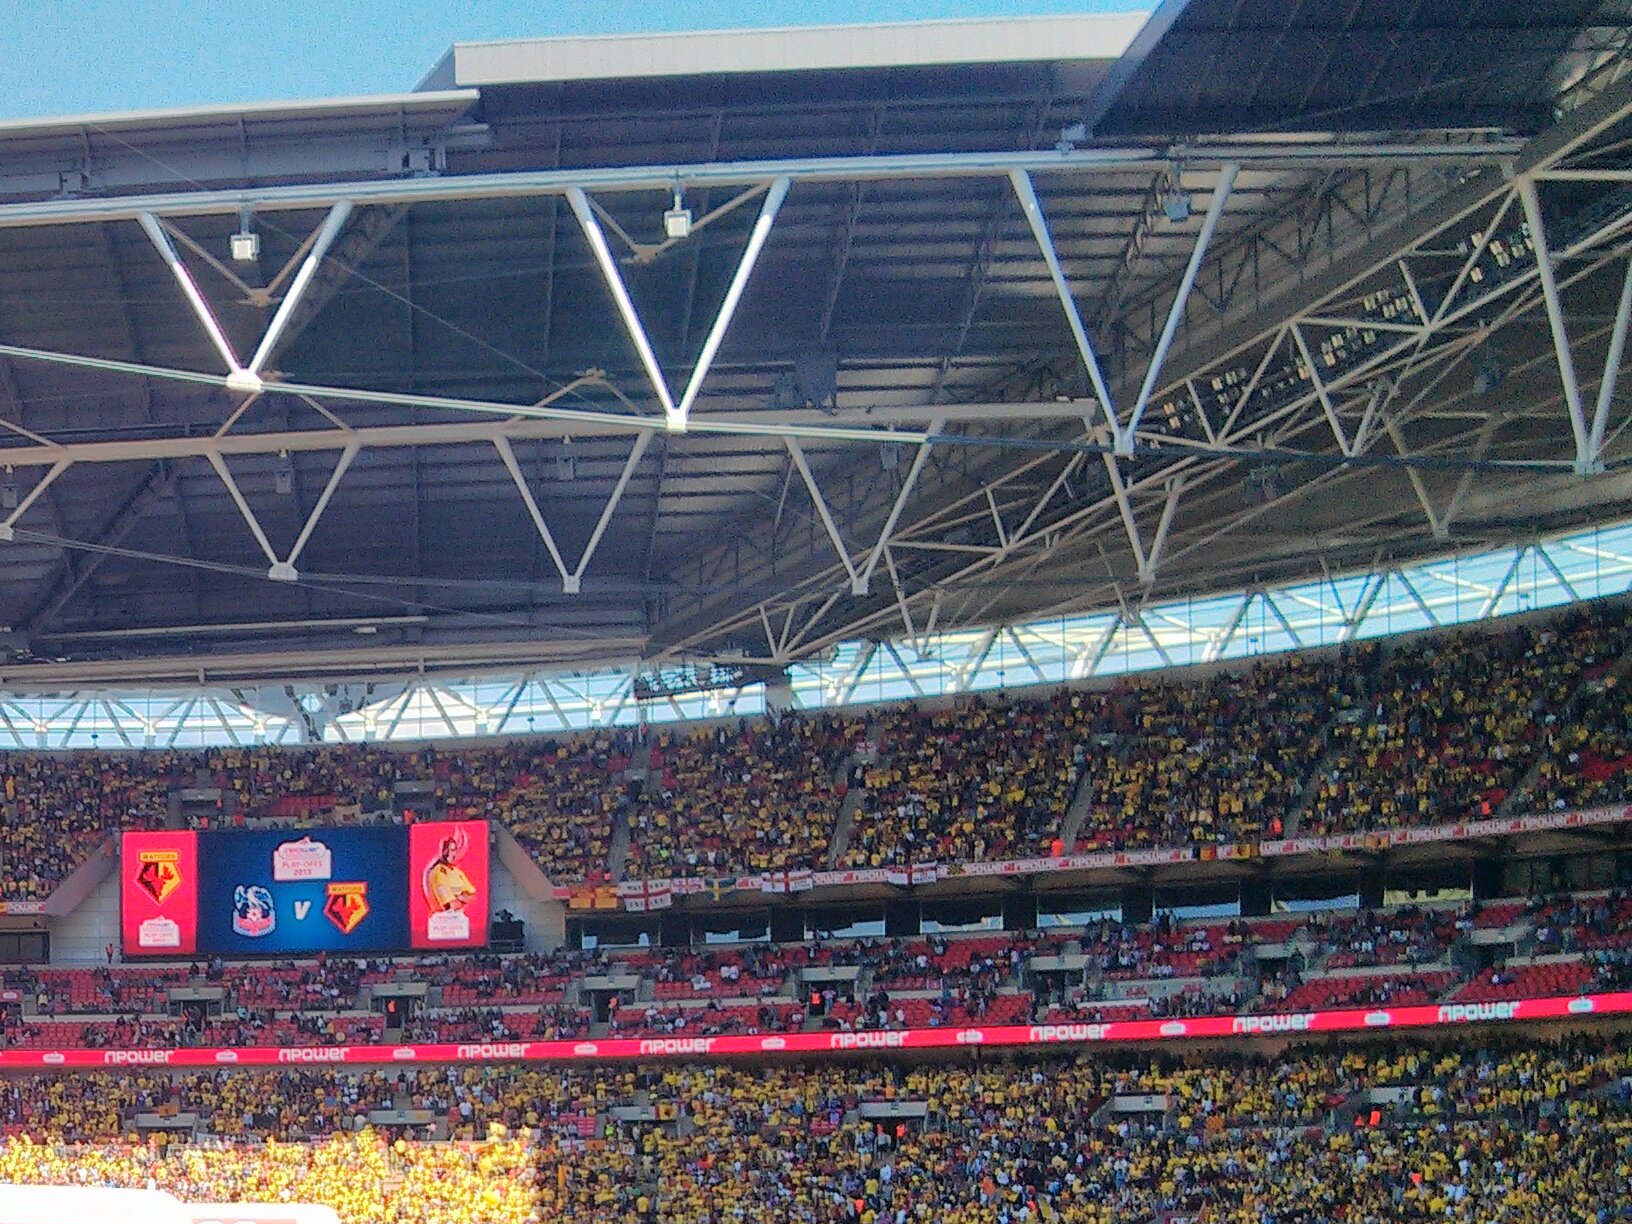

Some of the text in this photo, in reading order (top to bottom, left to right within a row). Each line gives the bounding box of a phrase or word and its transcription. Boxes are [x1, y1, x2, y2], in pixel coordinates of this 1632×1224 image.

[1438, 1001, 1520, 1021] npower
[1233, 1013, 1316, 1033] npower
[830, 1031, 909, 1050] npower
[1029, 1023, 1112, 1042] npower
[278, 1046, 350, 1062] npower
[457, 1042, 531, 1060] npower
[639, 1037, 716, 1055] npower
[104, 1049, 174, 1065] npower
